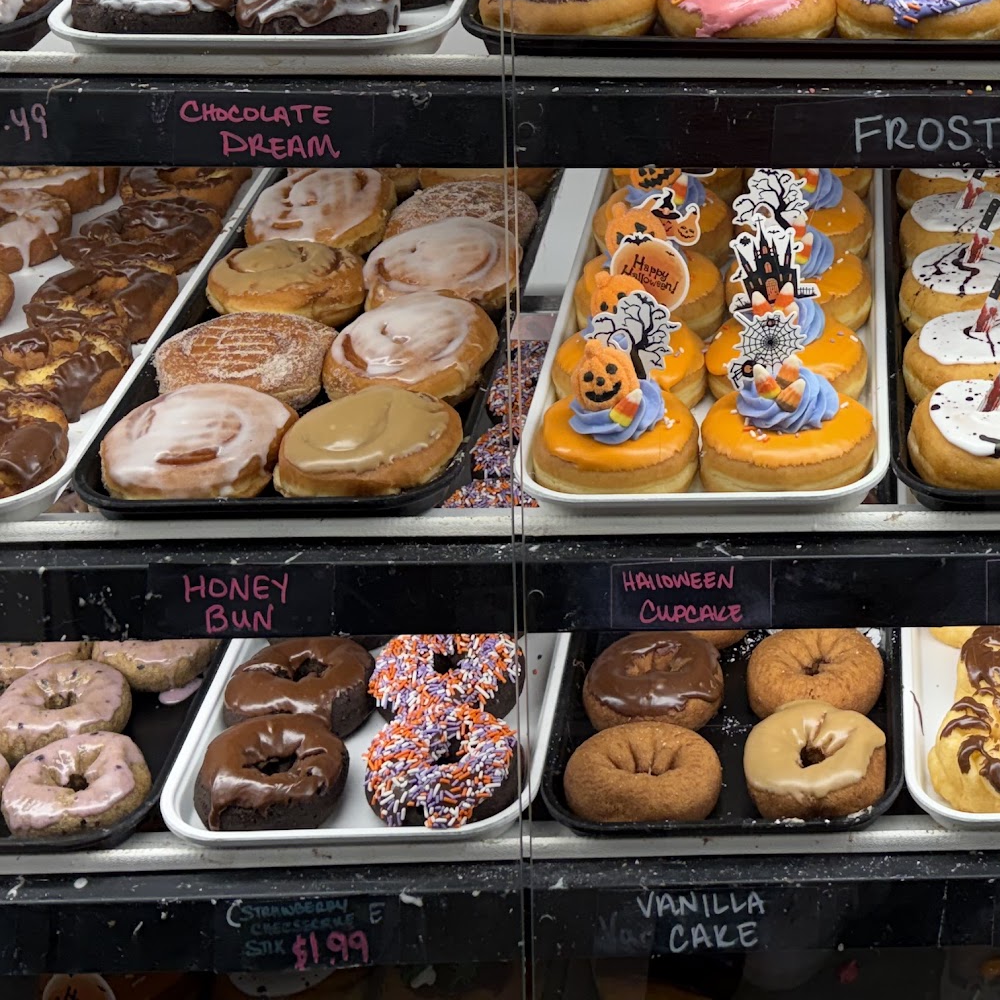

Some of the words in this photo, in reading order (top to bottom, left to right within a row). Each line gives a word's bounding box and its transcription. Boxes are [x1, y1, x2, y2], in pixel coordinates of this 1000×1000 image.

[179, 100, 333, 124] CHOCOLATE
[220, 130, 341, 160] DREAM
[632, 253, 670, 282] Happy
[183, 574, 290, 603] HONEY
[205, 605, 275, 633] BUN
[640, 599, 744, 623] CUPCAKE
[636, 890, 766, 918] VANILLA
[291, 929, 370, 971] $1.99
[668, 921, 760, 954] CAKE
